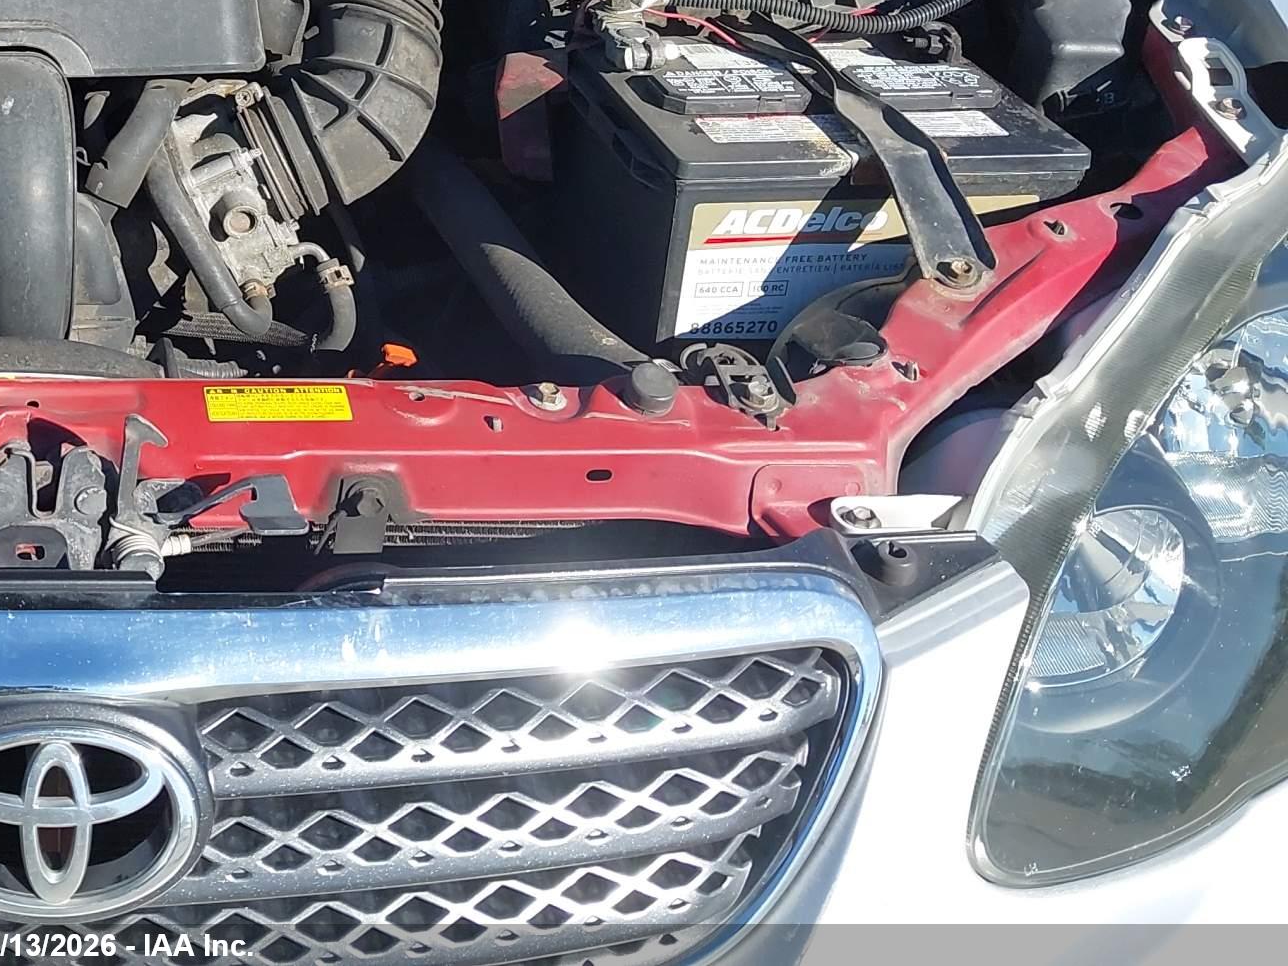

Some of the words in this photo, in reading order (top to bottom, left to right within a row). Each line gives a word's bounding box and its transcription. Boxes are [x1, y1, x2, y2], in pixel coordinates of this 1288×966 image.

[711, 206, 889, 235] ACDelco
[785, 255, 813, 264] FREE
[817, 253, 868, 263] BATTERY
[776, 264, 831, 274] ENTRETIEN
[719, 285, 739, 294] CCA
[752, 284, 769, 293] 100
[771, 284, 785, 292] RC
[690, 319, 778, 335] 88865270
